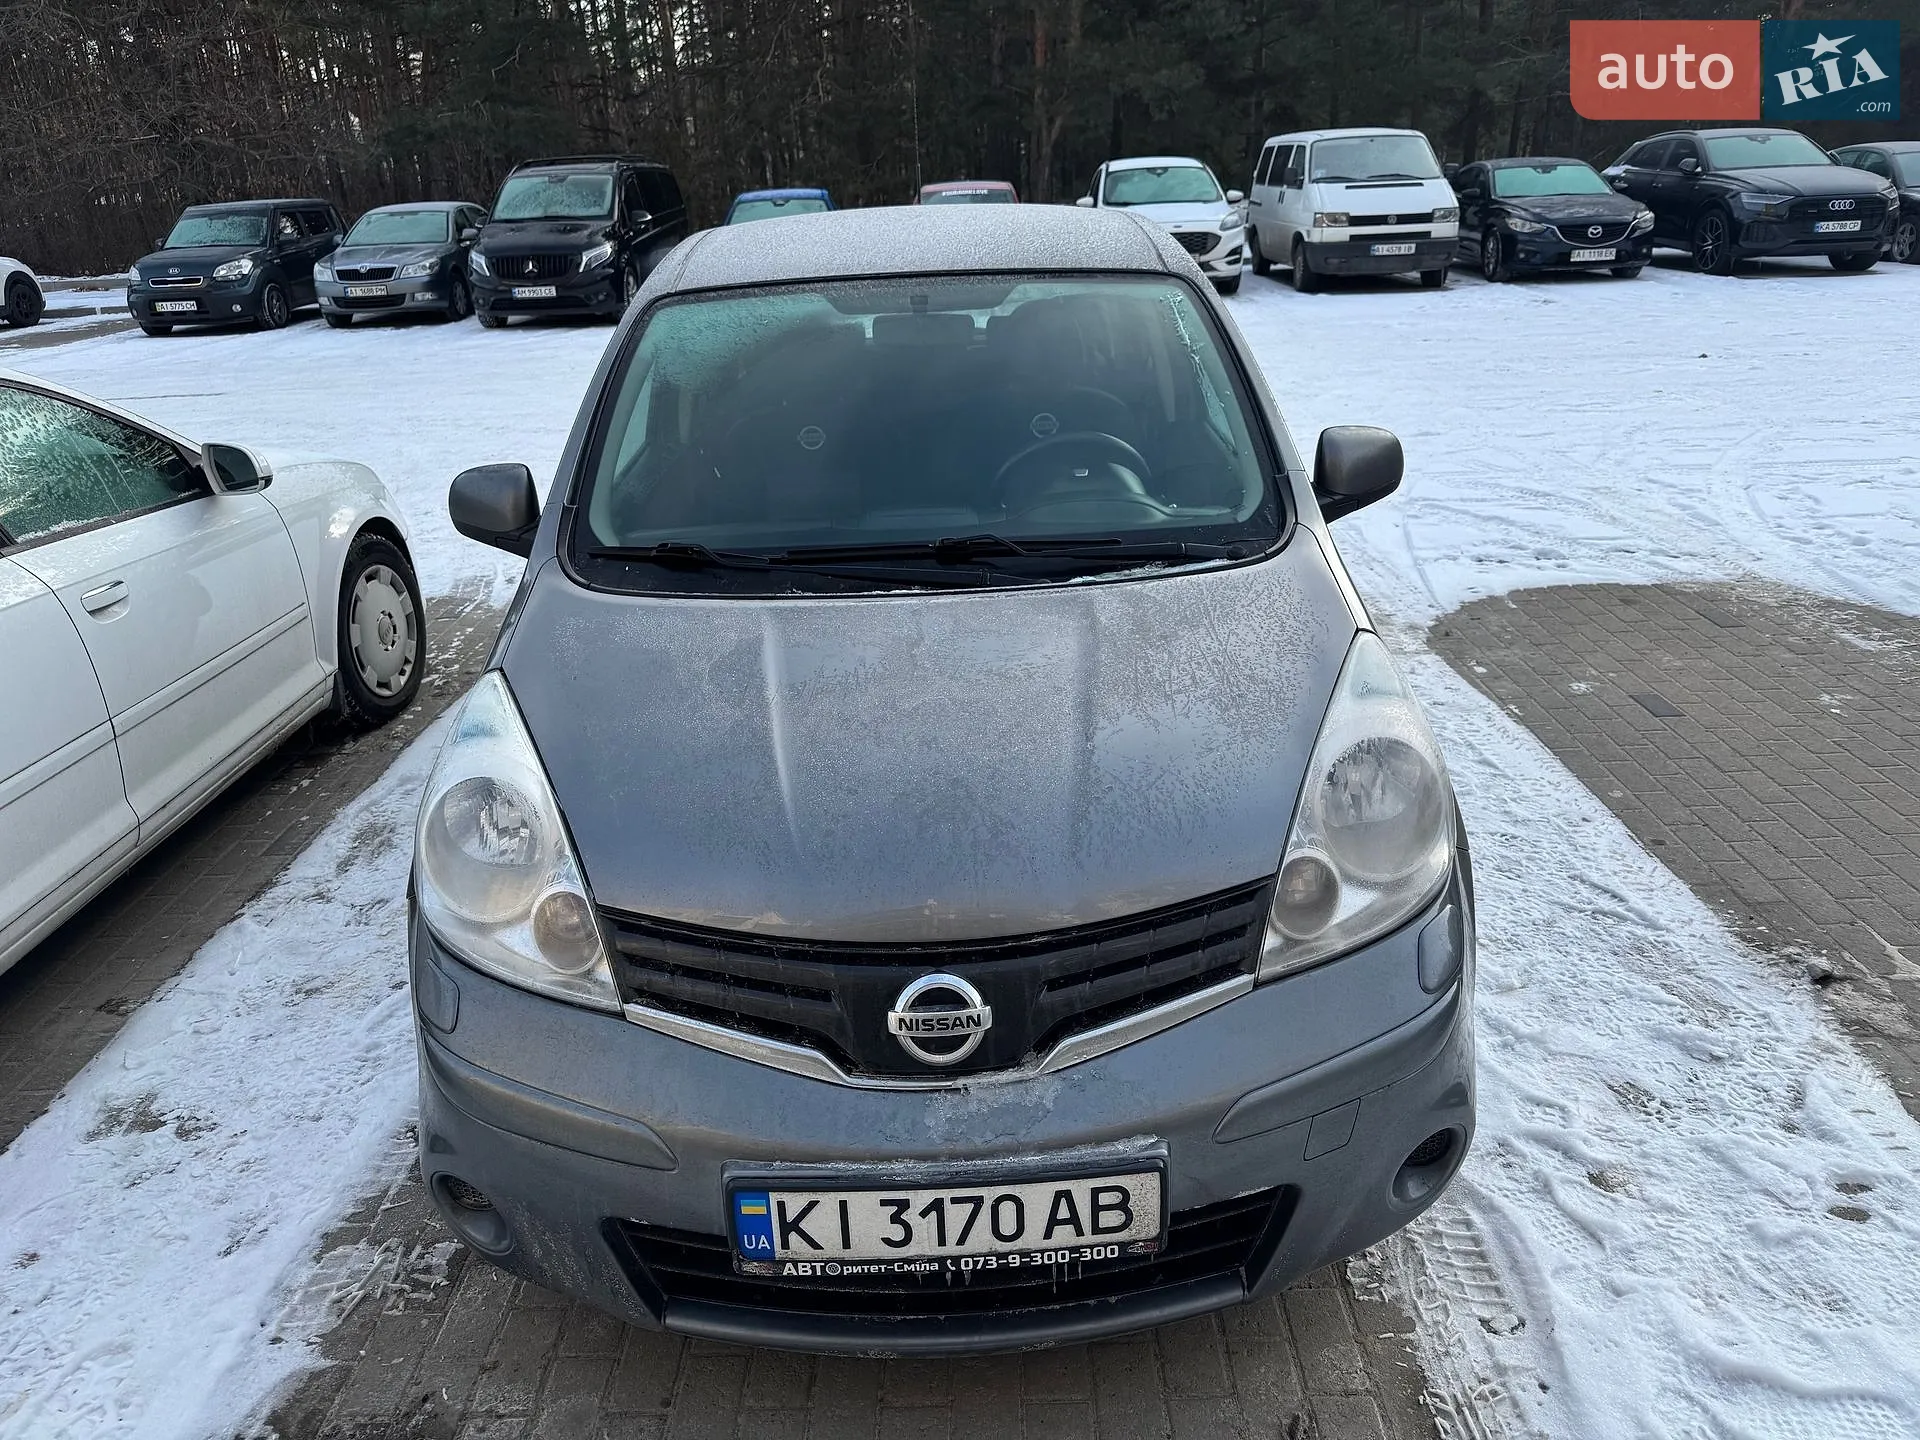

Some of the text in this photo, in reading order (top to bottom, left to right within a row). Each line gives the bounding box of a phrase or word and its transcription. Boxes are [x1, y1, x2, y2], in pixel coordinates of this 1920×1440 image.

[1820, 222, 1859, 231] KA 5788 CP
[1575, 250, 1585, 258] AI
[160, 303, 169, 311] AI
[169, 302, 185, 310] 5775
[898, 1013, 982, 1032] NISSAN
[743, 1184, 1134, 1251] UA KI 3170 AB
[960, 1244, 1119, 1270] 073-9-300-300
